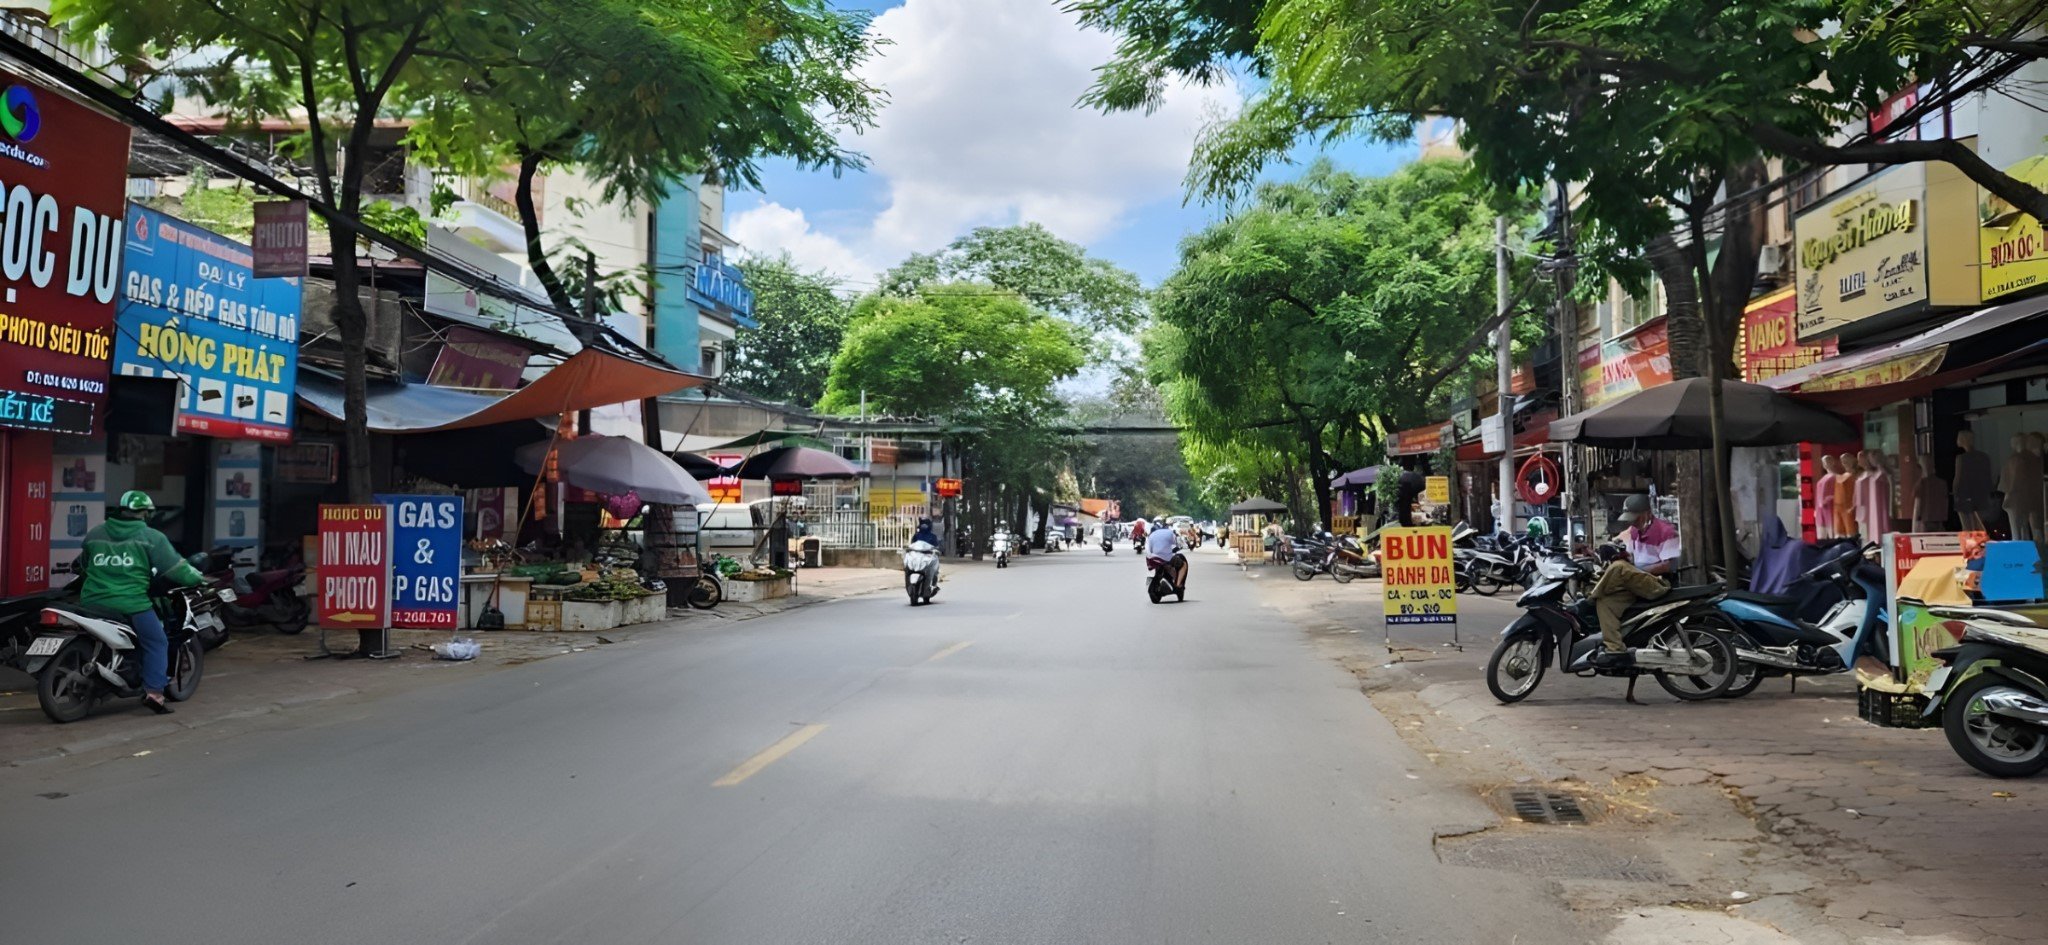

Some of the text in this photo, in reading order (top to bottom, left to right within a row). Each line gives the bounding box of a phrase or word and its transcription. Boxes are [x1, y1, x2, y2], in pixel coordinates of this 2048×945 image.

[256, 222, 304, 249] PHOTO
[127, 270, 162, 309] GAS
[166, 283, 180, 314] &
[218, 298, 248, 331] GAS
[0, 313, 46, 349] PHOTO
[84, 325, 110, 361] TỐC
[222, 343, 286, 385] PHÁT
[364, 507, 382, 520] DU
[398, 501, 455, 530] GAS
[93, 552, 135, 567] Grab
[322, 525, 382, 566] IN MÀU
[413, 538, 434, 565] &
[1386, 529, 1448, 561] BÚN
[324, 576, 377, 610] PHOTO
[414, 575, 454, 603] GAS
